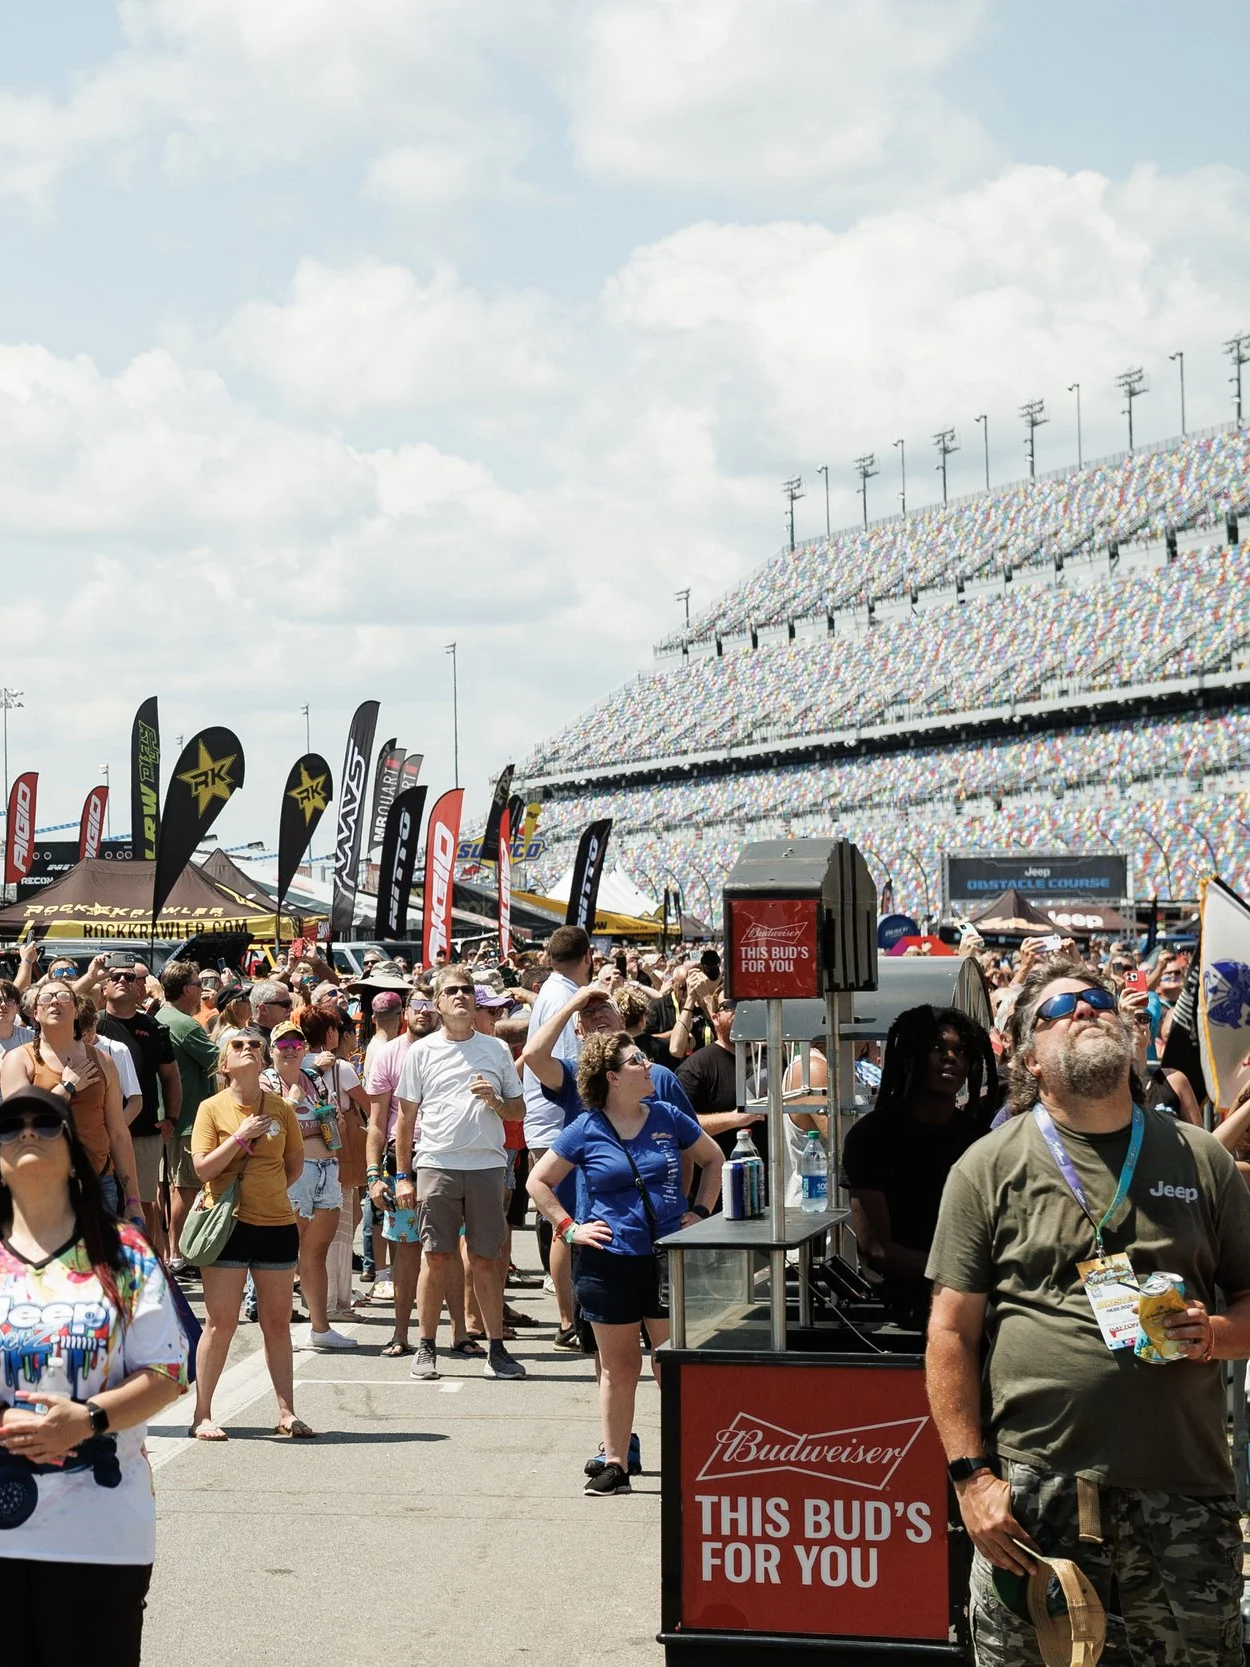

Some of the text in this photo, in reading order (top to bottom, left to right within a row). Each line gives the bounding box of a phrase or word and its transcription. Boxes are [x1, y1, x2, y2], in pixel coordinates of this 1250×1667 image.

[190, 763, 227, 792] RK
[300, 782, 323, 806] RK
[13, 781, 31, 874] RIGID
[85, 794, 101, 858] IGID
[140, 783, 158, 860] LRW
[456, 843, 541, 859] SUCO
[388, 810, 411, 932] NITTO
[1024, 866, 1050, 878] Jeep
[429, 821, 455, 967] RIGID
[966, 877, 1110, 891] OBSTACLE COURSE
[25, 903, 90, 917] ROCK
[83, 919, 248, 940] ROCKKRAWLERCOM
[745, 926, 801, 938] Budweiser
[740, 946, 809, 959] THIS BUD'S
[741, 960, 794, 973] FOR YOU
[1150, 1180, 1198, 1204] Jeep
[1110, 1321, 1139, 1333] DAYTON
[715, 1428, 904, 1464] Budweiser
[694, 1495, 932, 1544] THIS BUD'S
[701, 1541, 879, 1589] FOR YOU
